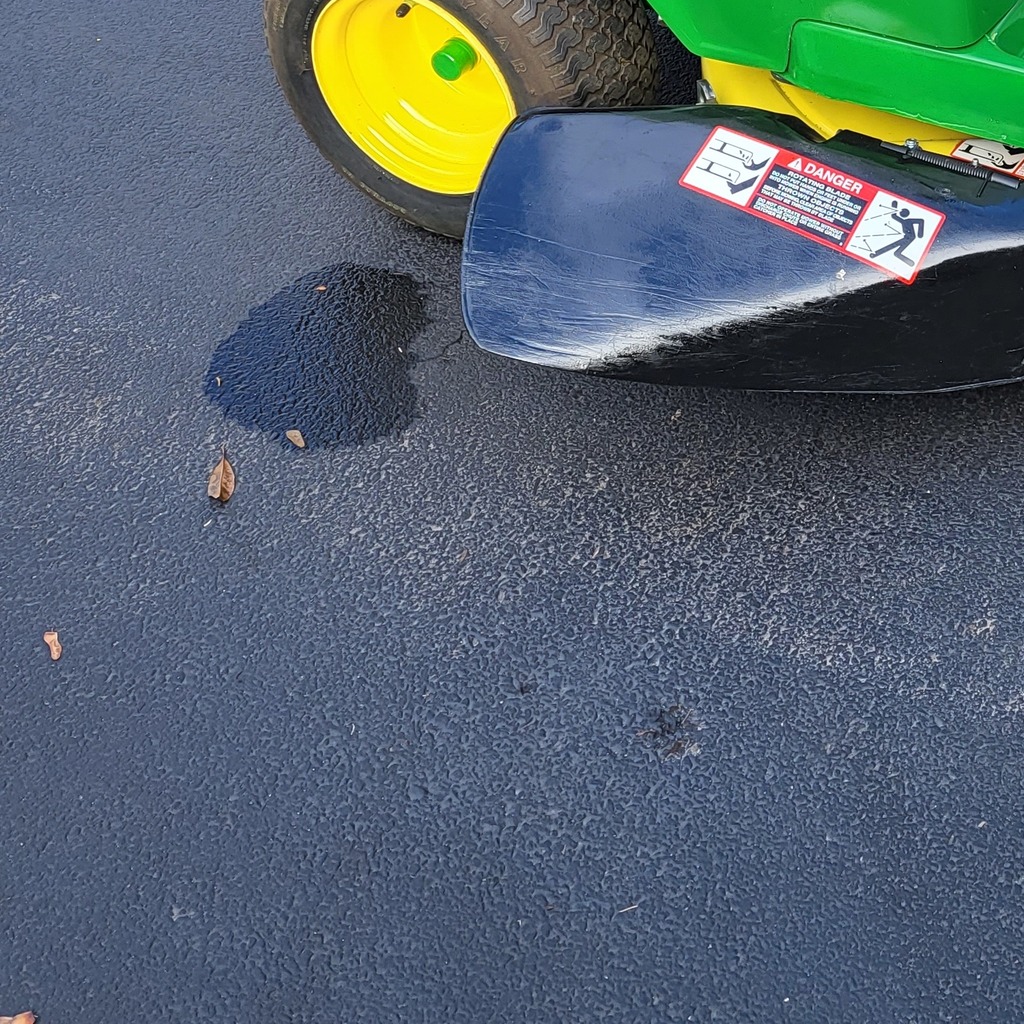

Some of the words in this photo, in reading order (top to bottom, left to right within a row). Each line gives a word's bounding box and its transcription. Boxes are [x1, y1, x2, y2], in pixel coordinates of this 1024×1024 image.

[787, 170, 825, 189] ROTATING
[825, 186, 851, 200] BLADE
[803, 162, 864, 194] DANGER
[776, 184, 810, 201] THROWN
[809, 197, 844, 215] OBJECTS
